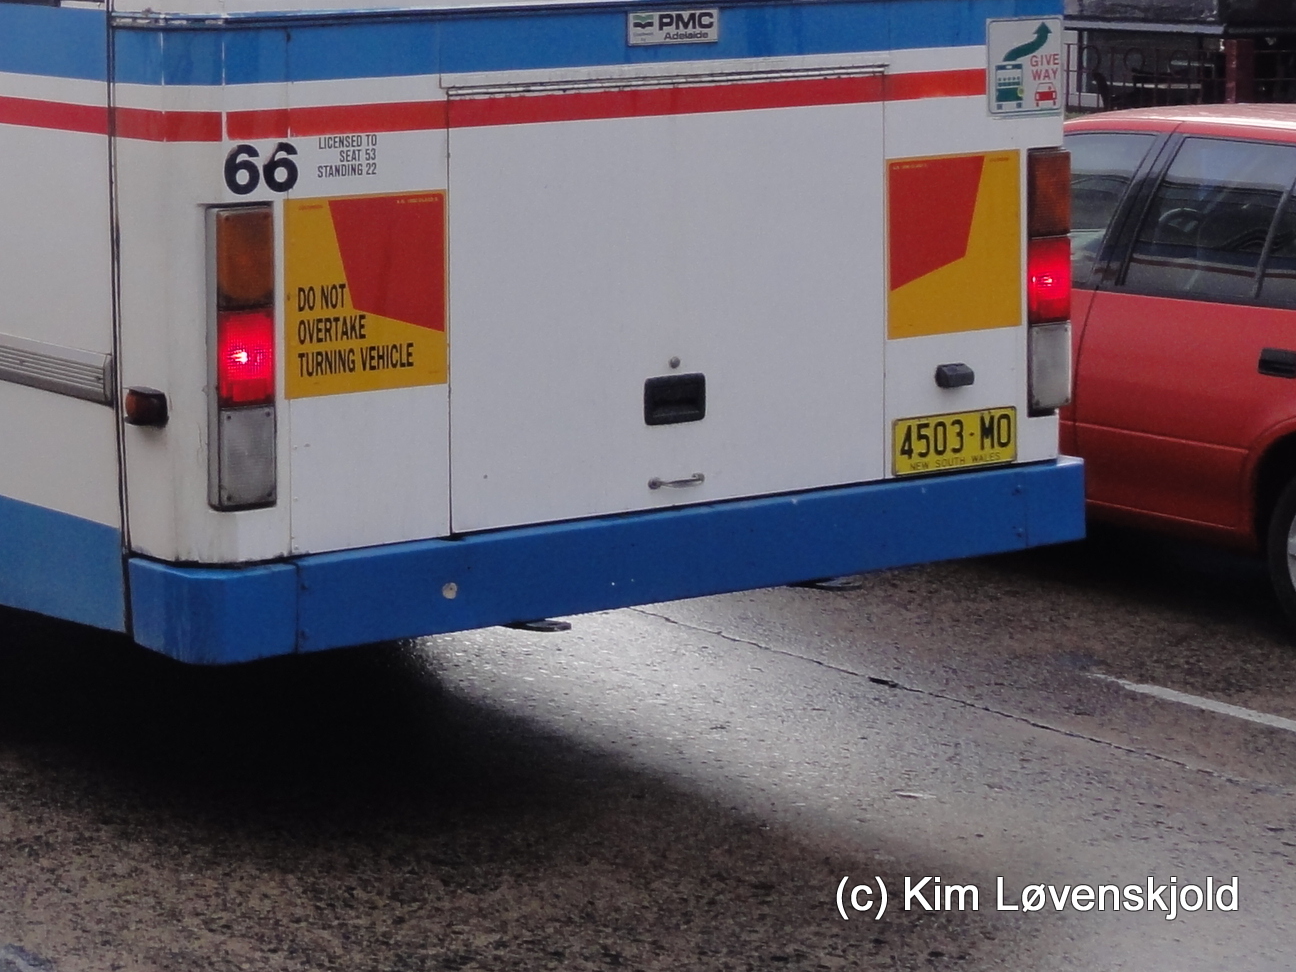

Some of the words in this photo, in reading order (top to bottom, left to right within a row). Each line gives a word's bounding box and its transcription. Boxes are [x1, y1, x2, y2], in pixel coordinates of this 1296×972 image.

[658, 12, 714, 31] PMC
[664, 31, 709, 41] Adelaide
[1030, 54, 1060, 67] GIVE
[1032, 68, 1058, 81] WAY
[318, 135, 363, 150] LICENSED
[366, 134, 377, 146] TO
[339, 149, 362, 163] SEAT
[365, 148, 377, 161] 53
[224, 142, 299, 196] 66
[317, 164, 363, 178] STANDING
[365, 162, 377, 176] 22
[297, 286, 316, 312] DO
[321, 283, 346, 310] NOT
[297, 314, 367, 345] OVERTAKE
[297, 347, 356, 378] TURNING
[360, 342, 414, 372] VEHICLE
[909, 462, 930, 471] NEW
[935, 457, 966, 468] SOUTH
[971, 451, 1001, 463] WALES
